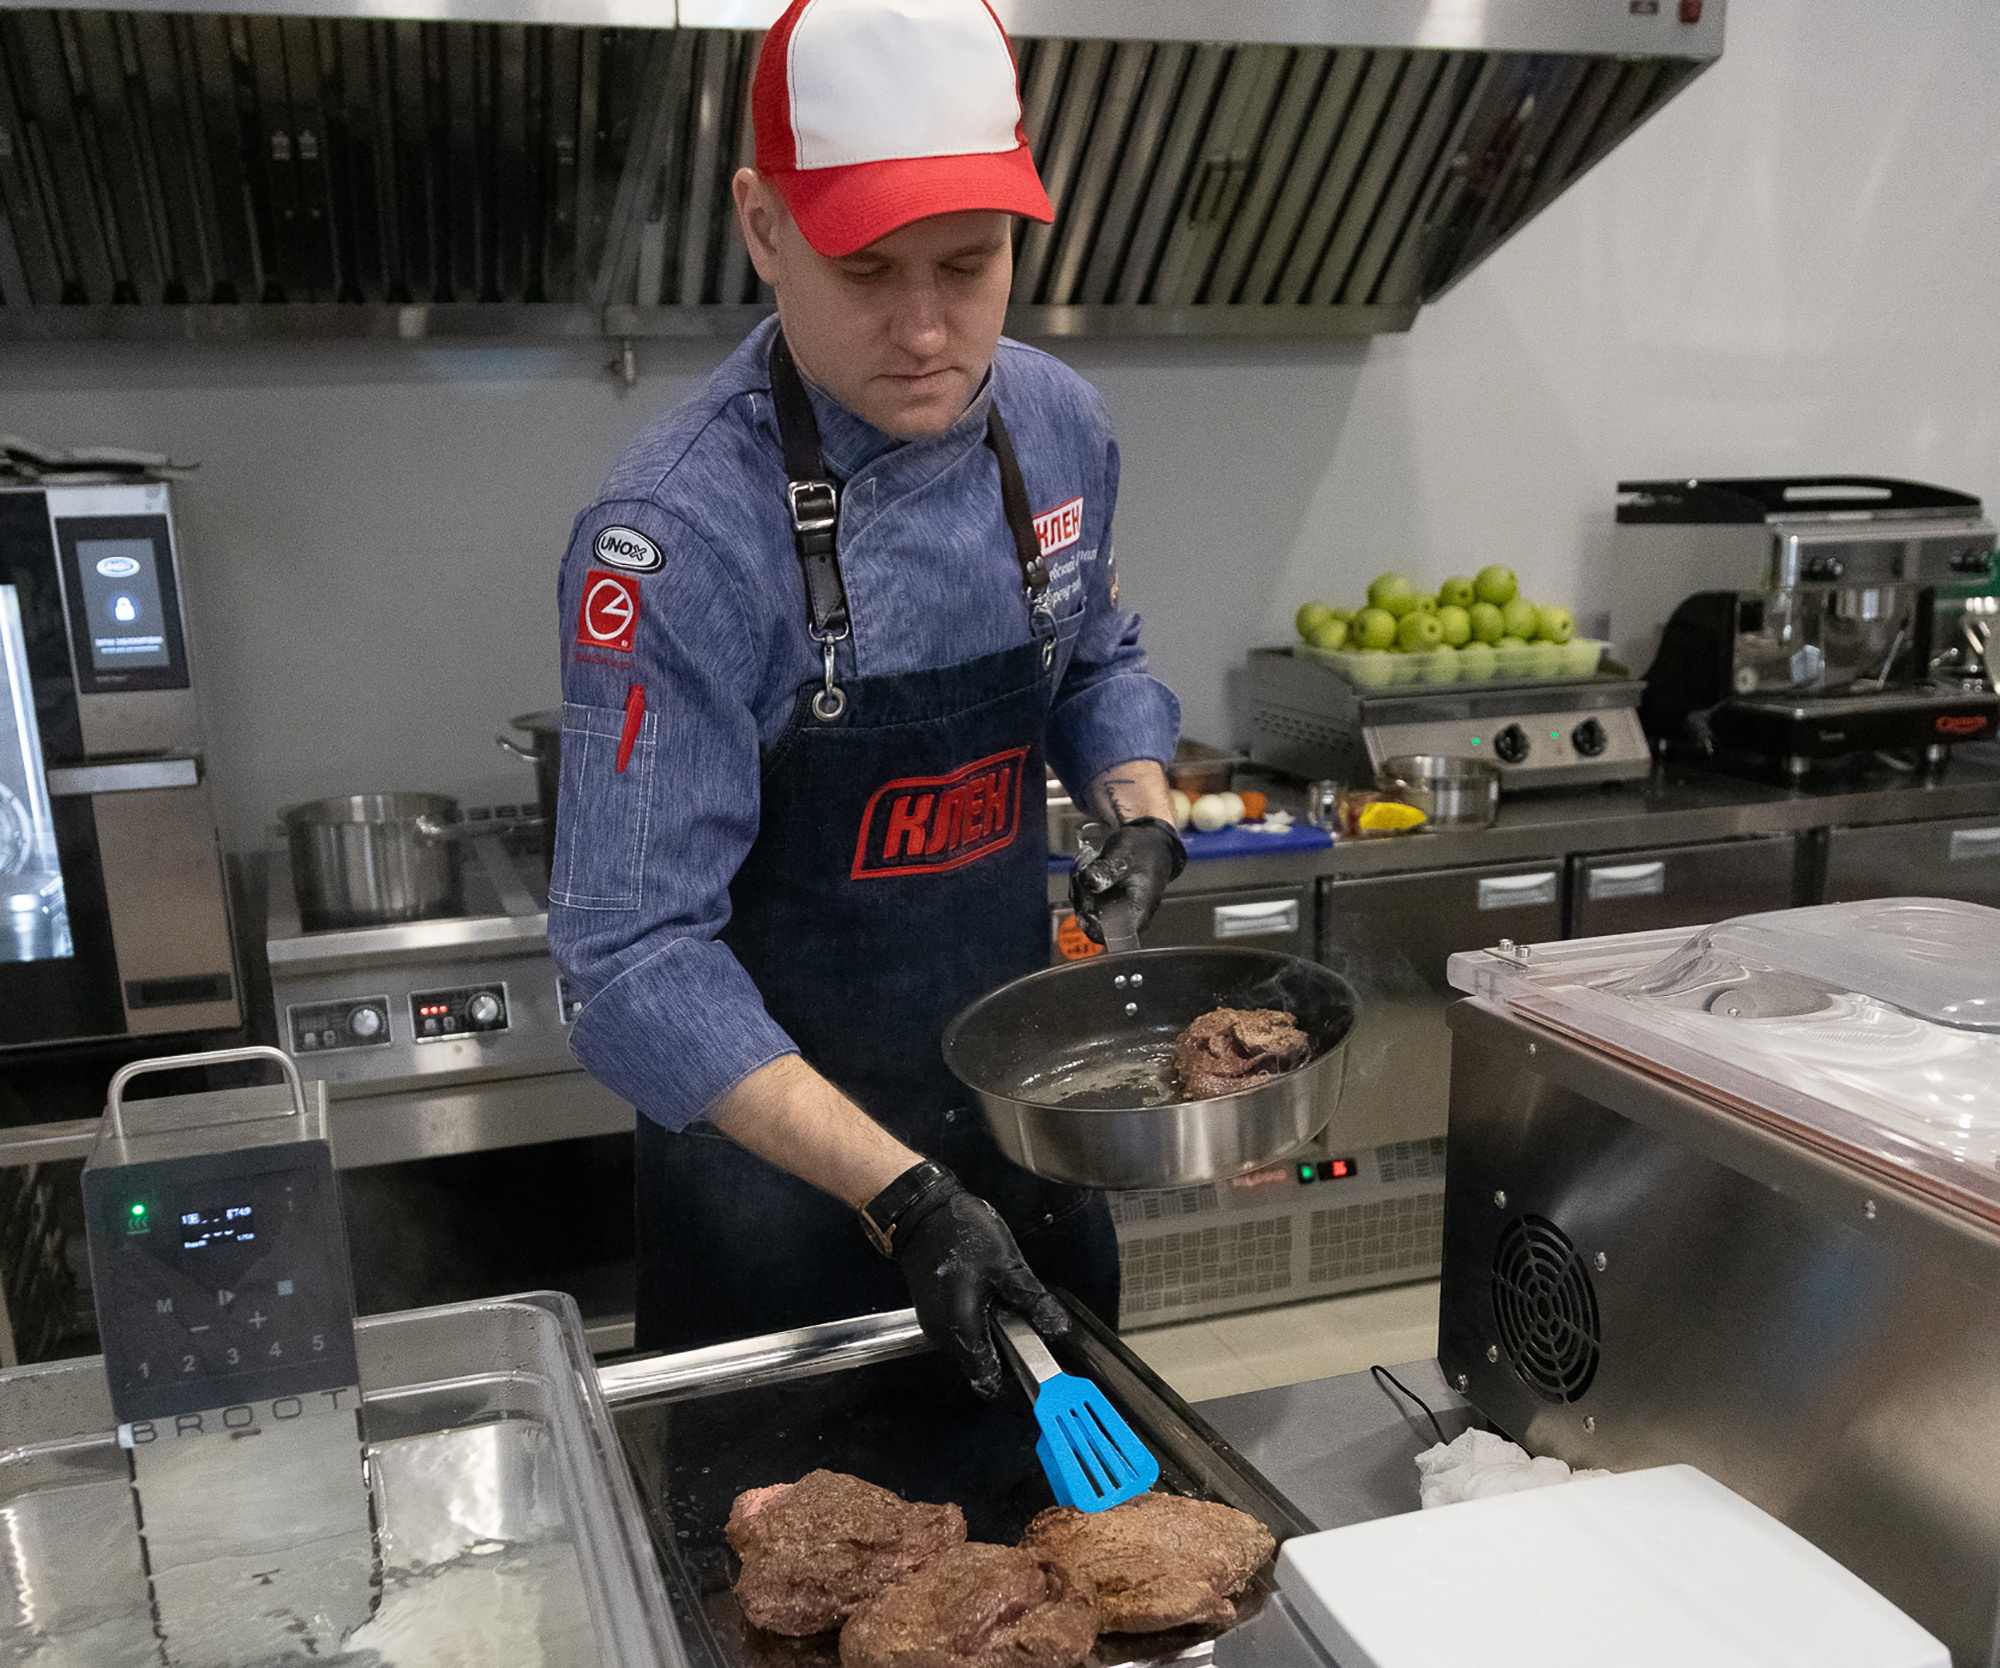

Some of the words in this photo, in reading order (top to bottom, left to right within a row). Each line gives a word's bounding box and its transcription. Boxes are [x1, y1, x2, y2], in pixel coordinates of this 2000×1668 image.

[1036, 505, 1079, 548] КЛЕН
[600, 536, 647, 561] UNOX
[883, 768, 1010, 858] КЛЕН
[156, 1298, 173, 1314] M
[138, 1362, 149, 1378] 1
[183, 1355, 195, 1372] 2
[227, 1348, 240, 1365] 3
[268, 1341, 282, 1357] 4
[312, 1334, 324, 1351] 5
[132, 1388, 348, 1444] BROOT
